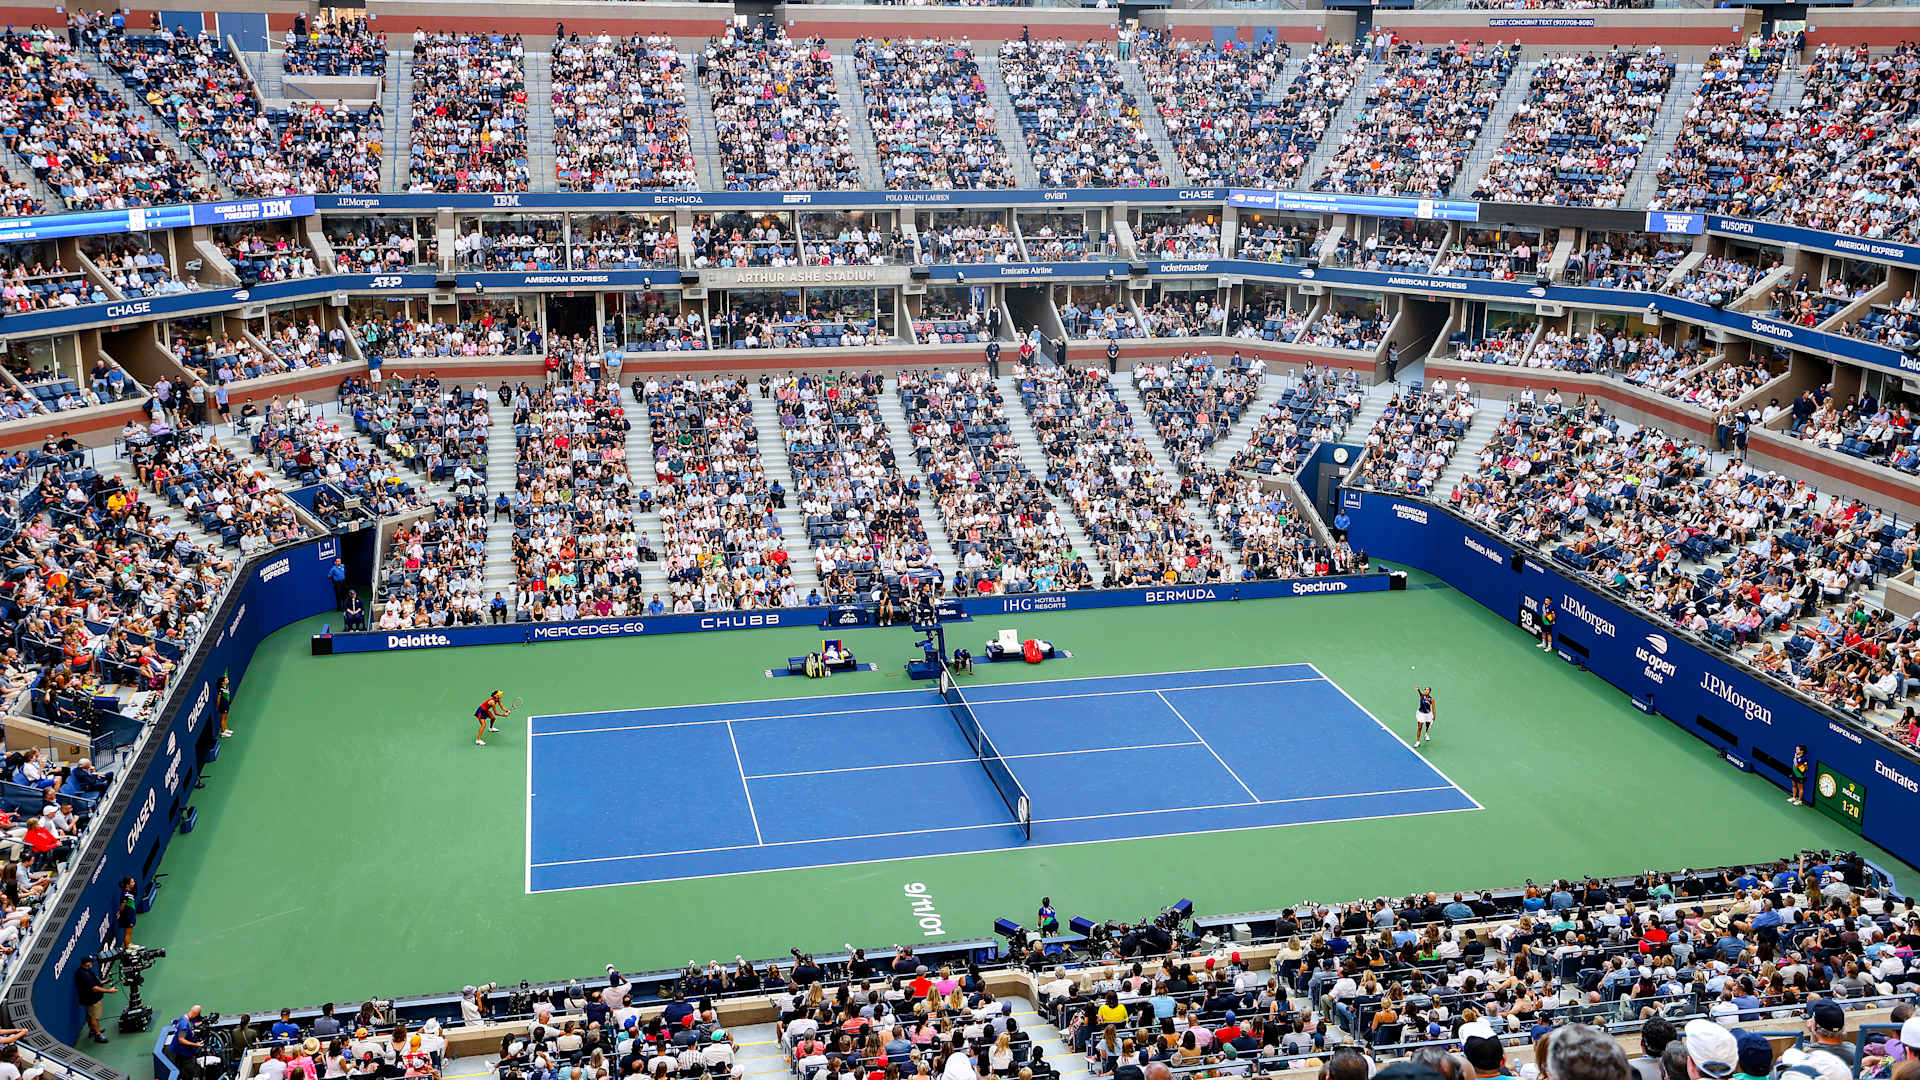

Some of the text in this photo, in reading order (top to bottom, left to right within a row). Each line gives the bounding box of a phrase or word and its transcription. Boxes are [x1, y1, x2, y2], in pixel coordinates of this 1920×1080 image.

[493, 195, 521, 206] IBM
[654, 195, 703, 204] BERMUDA
[782, 194, 812, 203] ESPN
[1044, 191, 1068, 200] evian
[1179, 190, 1215, 199] CHASE
[262, 200, 292, 218] IBM
[337, 198, 379, 208] J.P.Morgan
[1720, 220, 1754, 233] #USOPEN
[1834, 240, 1904, 258] AMERICAN EXPRESS
[1000, 267, 1030, 275] Emirates
[1160, 263, 1209, 272] ticketmaster
[369, 277, 402, 288] ATP
[524, 275, 609, 284] AMERICAN EXPRESS
[736, 270, 876, 283] ARTHUR ASHE STADIUM
[1388, 277, 1468, 290] AMERICAN EXPRESS
[106, 302, 151, 317] CHASE
[1751, 320, 1791, 338] Spectrum
[1392, 503, 1428, 519] AMERICAN
[1397, 510, 1428, 525] EXPRESS
[260, 558, 289, 577] AMERICAN
[263, 566, 290, 583] EXPRESS
[1145, 588, 1216, 602] BERMUDA
[1292, 581, 1344, 596] Spectrum
[1003, 598, 1032, 612] IHG
[1524, 595, 1538, 612] IBM
[701, 614, 780, 629] CHUBB
[839, 617, 858, 625] evian
[1520, 609, 1533, 626] 98
[1560, 593, 1616, 638] J.P.Morgan
[534, 622, 644, 639] MERCEDES-EQ
[388, 634, 450, 648] Deloitte.
[1635, 647, 1676, 678] us open
[1643, 666, 1664, 685] finals
[1700, 671, 1772, 726] J.P.Morgan
[187, 687, 206, 733] CHASE
[1829, 722, 1863, 745] USOPEN.ORG
[1874, 759, 1919, 793] Emirates
[1842, 787, 1861, 803] ROLEX
[127, 799, 150, 855] CHASE
[904, 882, 946, 937] 9/11/01
